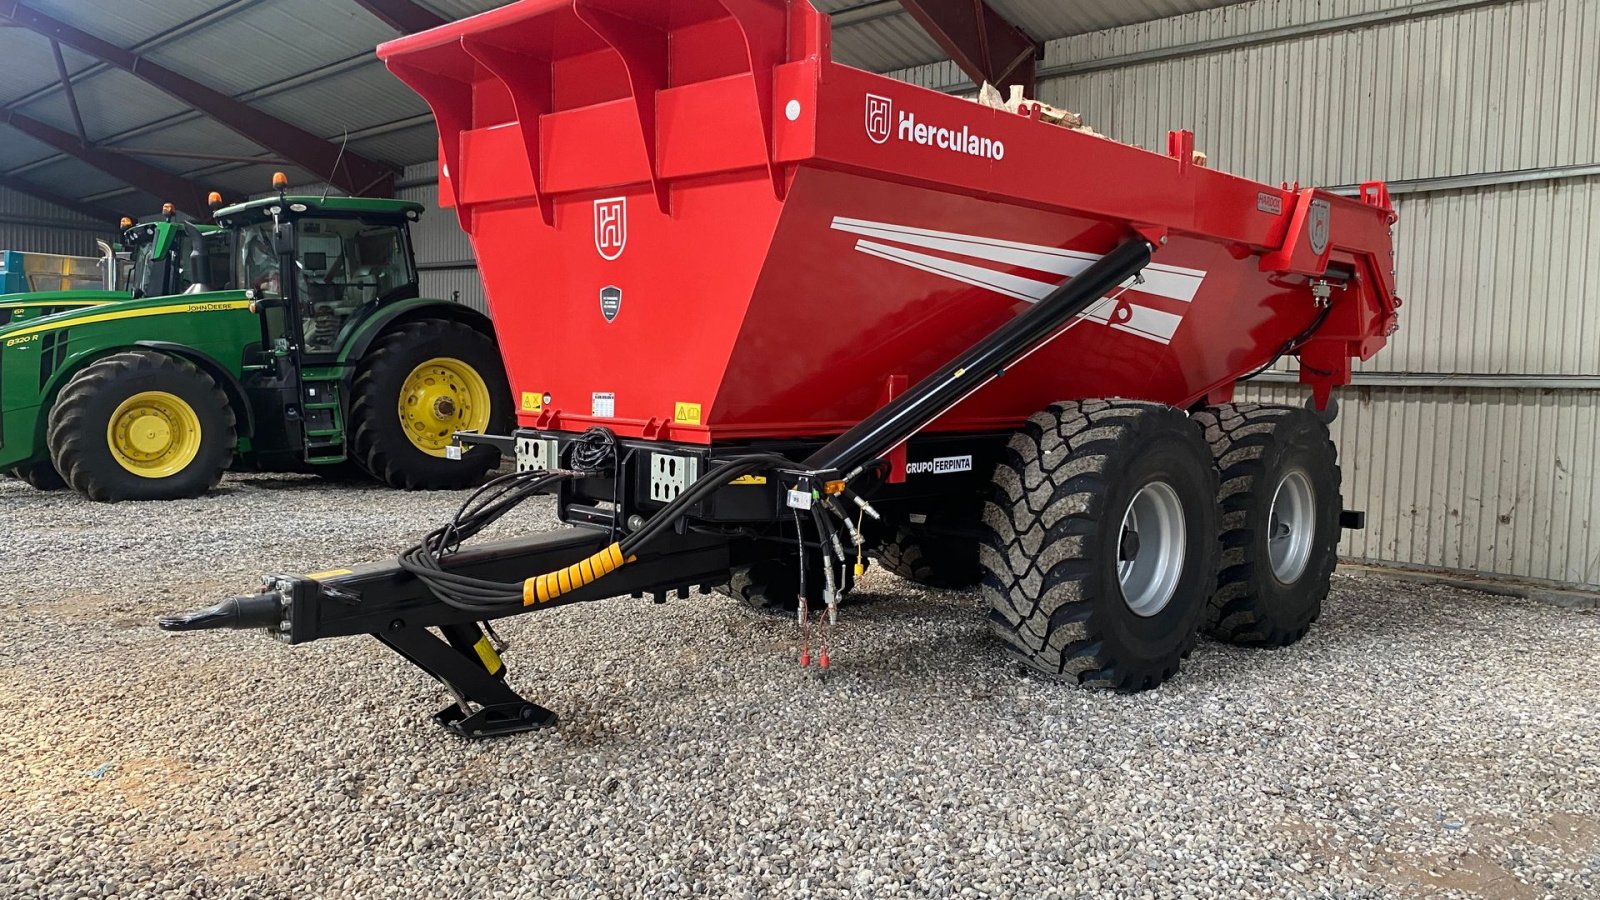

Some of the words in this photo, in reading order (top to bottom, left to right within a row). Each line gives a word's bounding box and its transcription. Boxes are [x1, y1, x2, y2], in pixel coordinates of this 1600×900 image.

[898, 110, 1004, 161] Herculano
[187, 304, 207, 312] JOHN
[7, 336, 30, 348] 8320
[31, 334, 39, 342] R
[906, 461, 933, 474] GRUPO
[935, 457, 970, 471] FERPINTA
